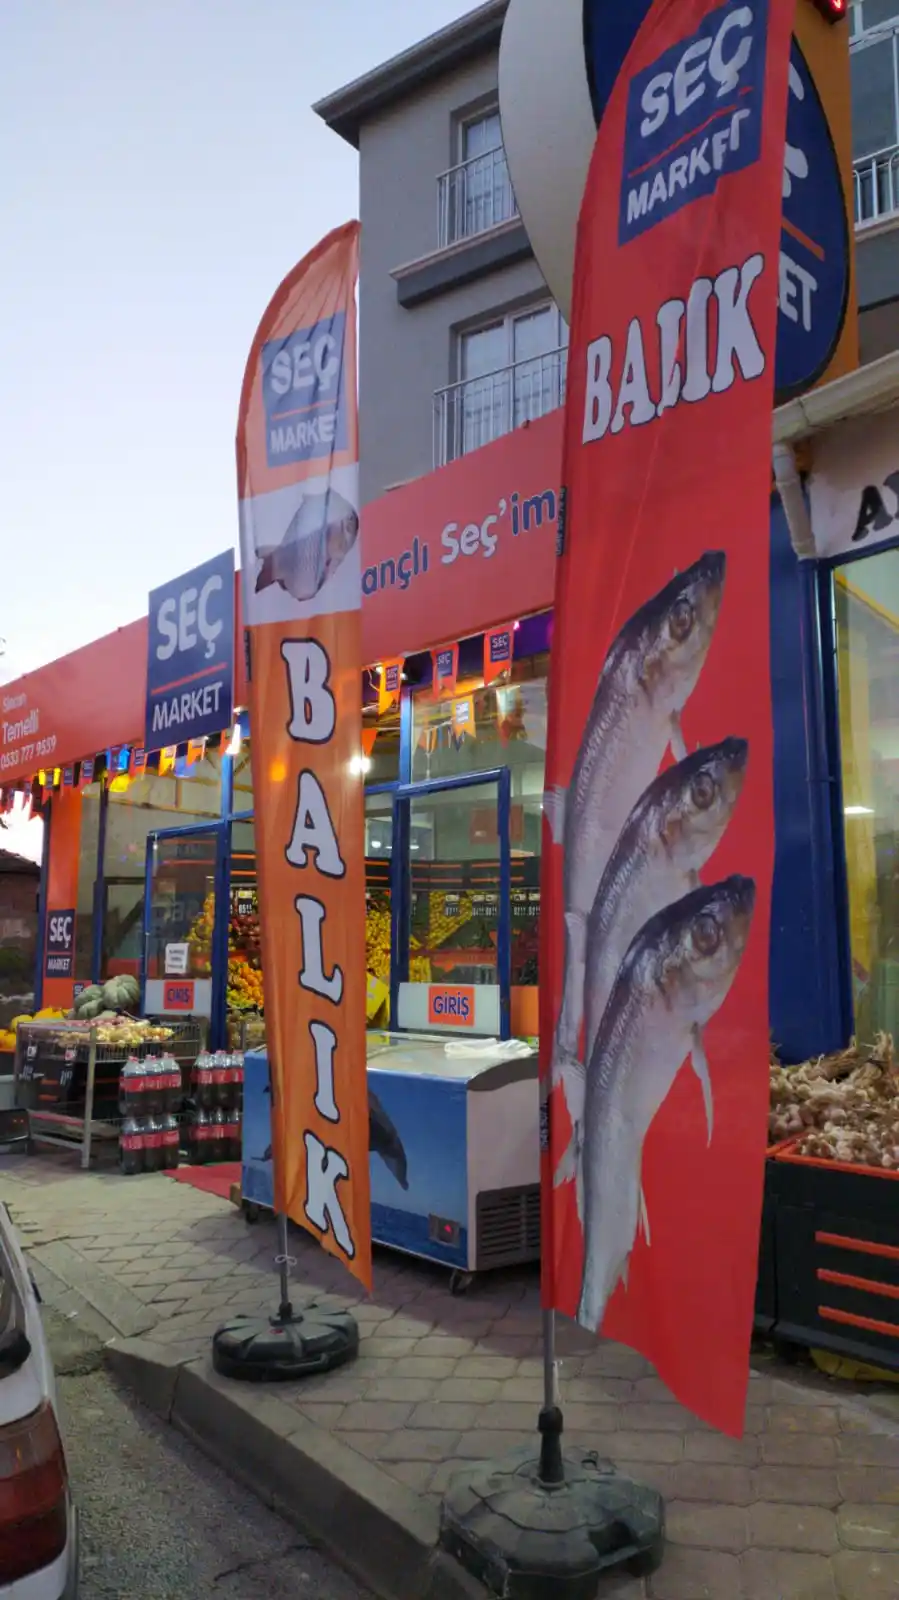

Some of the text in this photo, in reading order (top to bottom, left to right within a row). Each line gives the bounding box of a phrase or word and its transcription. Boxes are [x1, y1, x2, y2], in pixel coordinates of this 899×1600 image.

[640, 5, 754, 138] SEÇ
[779, 250, 818, 332] ET
[271, 333, 337, 396] SEÇ
[582, 254, 766, 445] BALIK
[270, 411, 336, 455] MARKE
[362, 535, 429, 596] ançlı
[156, 574, 223, 661] SEÇ
[152, 681, 223, 732] MARKET
[20, 743, 35, 764] 777
[49, 916, 72, 949] SEÇ
[279, 636, 356, 1261] BALIK
[47, 957, 71, 971] MARKET
[433, 991, 470, 1021] GİRİŞ
